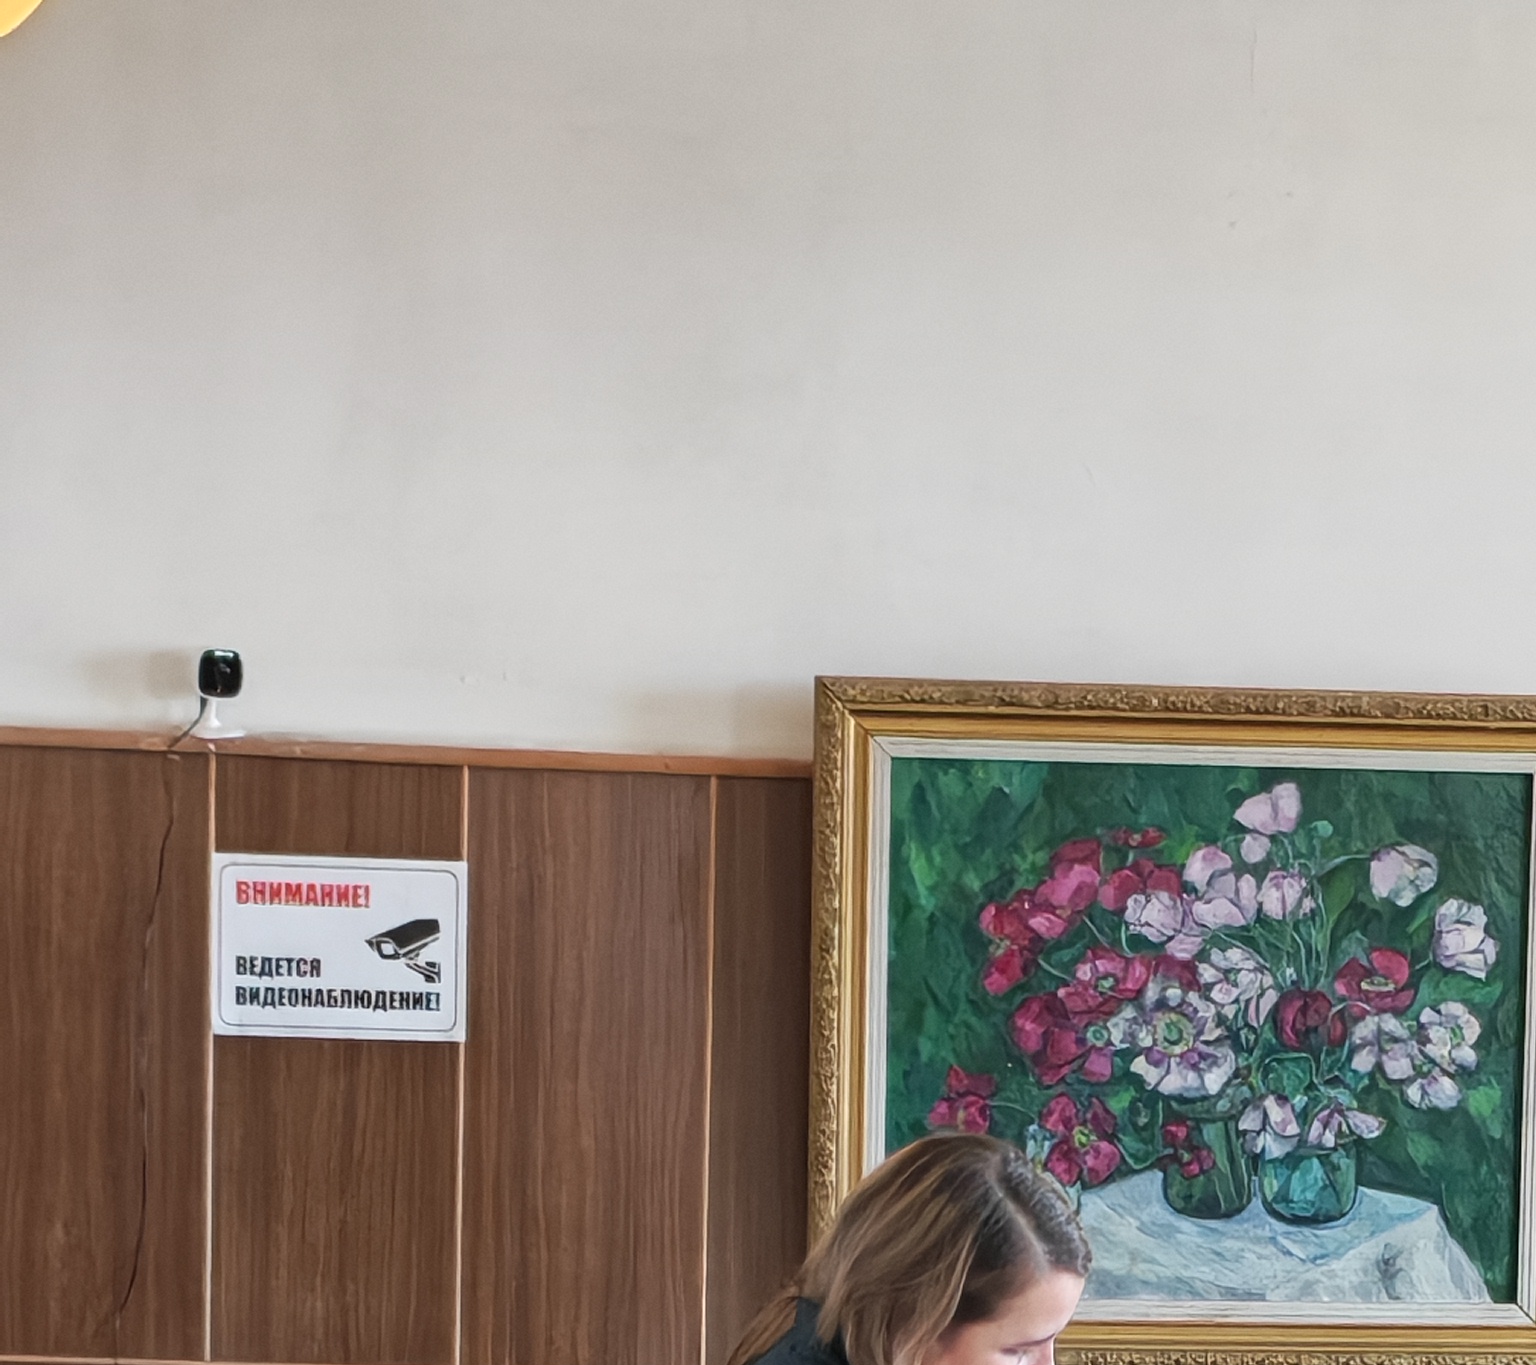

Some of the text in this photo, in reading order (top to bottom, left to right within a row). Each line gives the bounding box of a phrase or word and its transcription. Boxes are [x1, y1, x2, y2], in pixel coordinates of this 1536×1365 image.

[235, 880, 370, 908] ВНИМАНИЕ!
[235, 955, 321, 980] ВЕДЕТСЯ
[235, 985, 441, 1012] ВИДЕОНАБЛЮДЕНИЕ!
